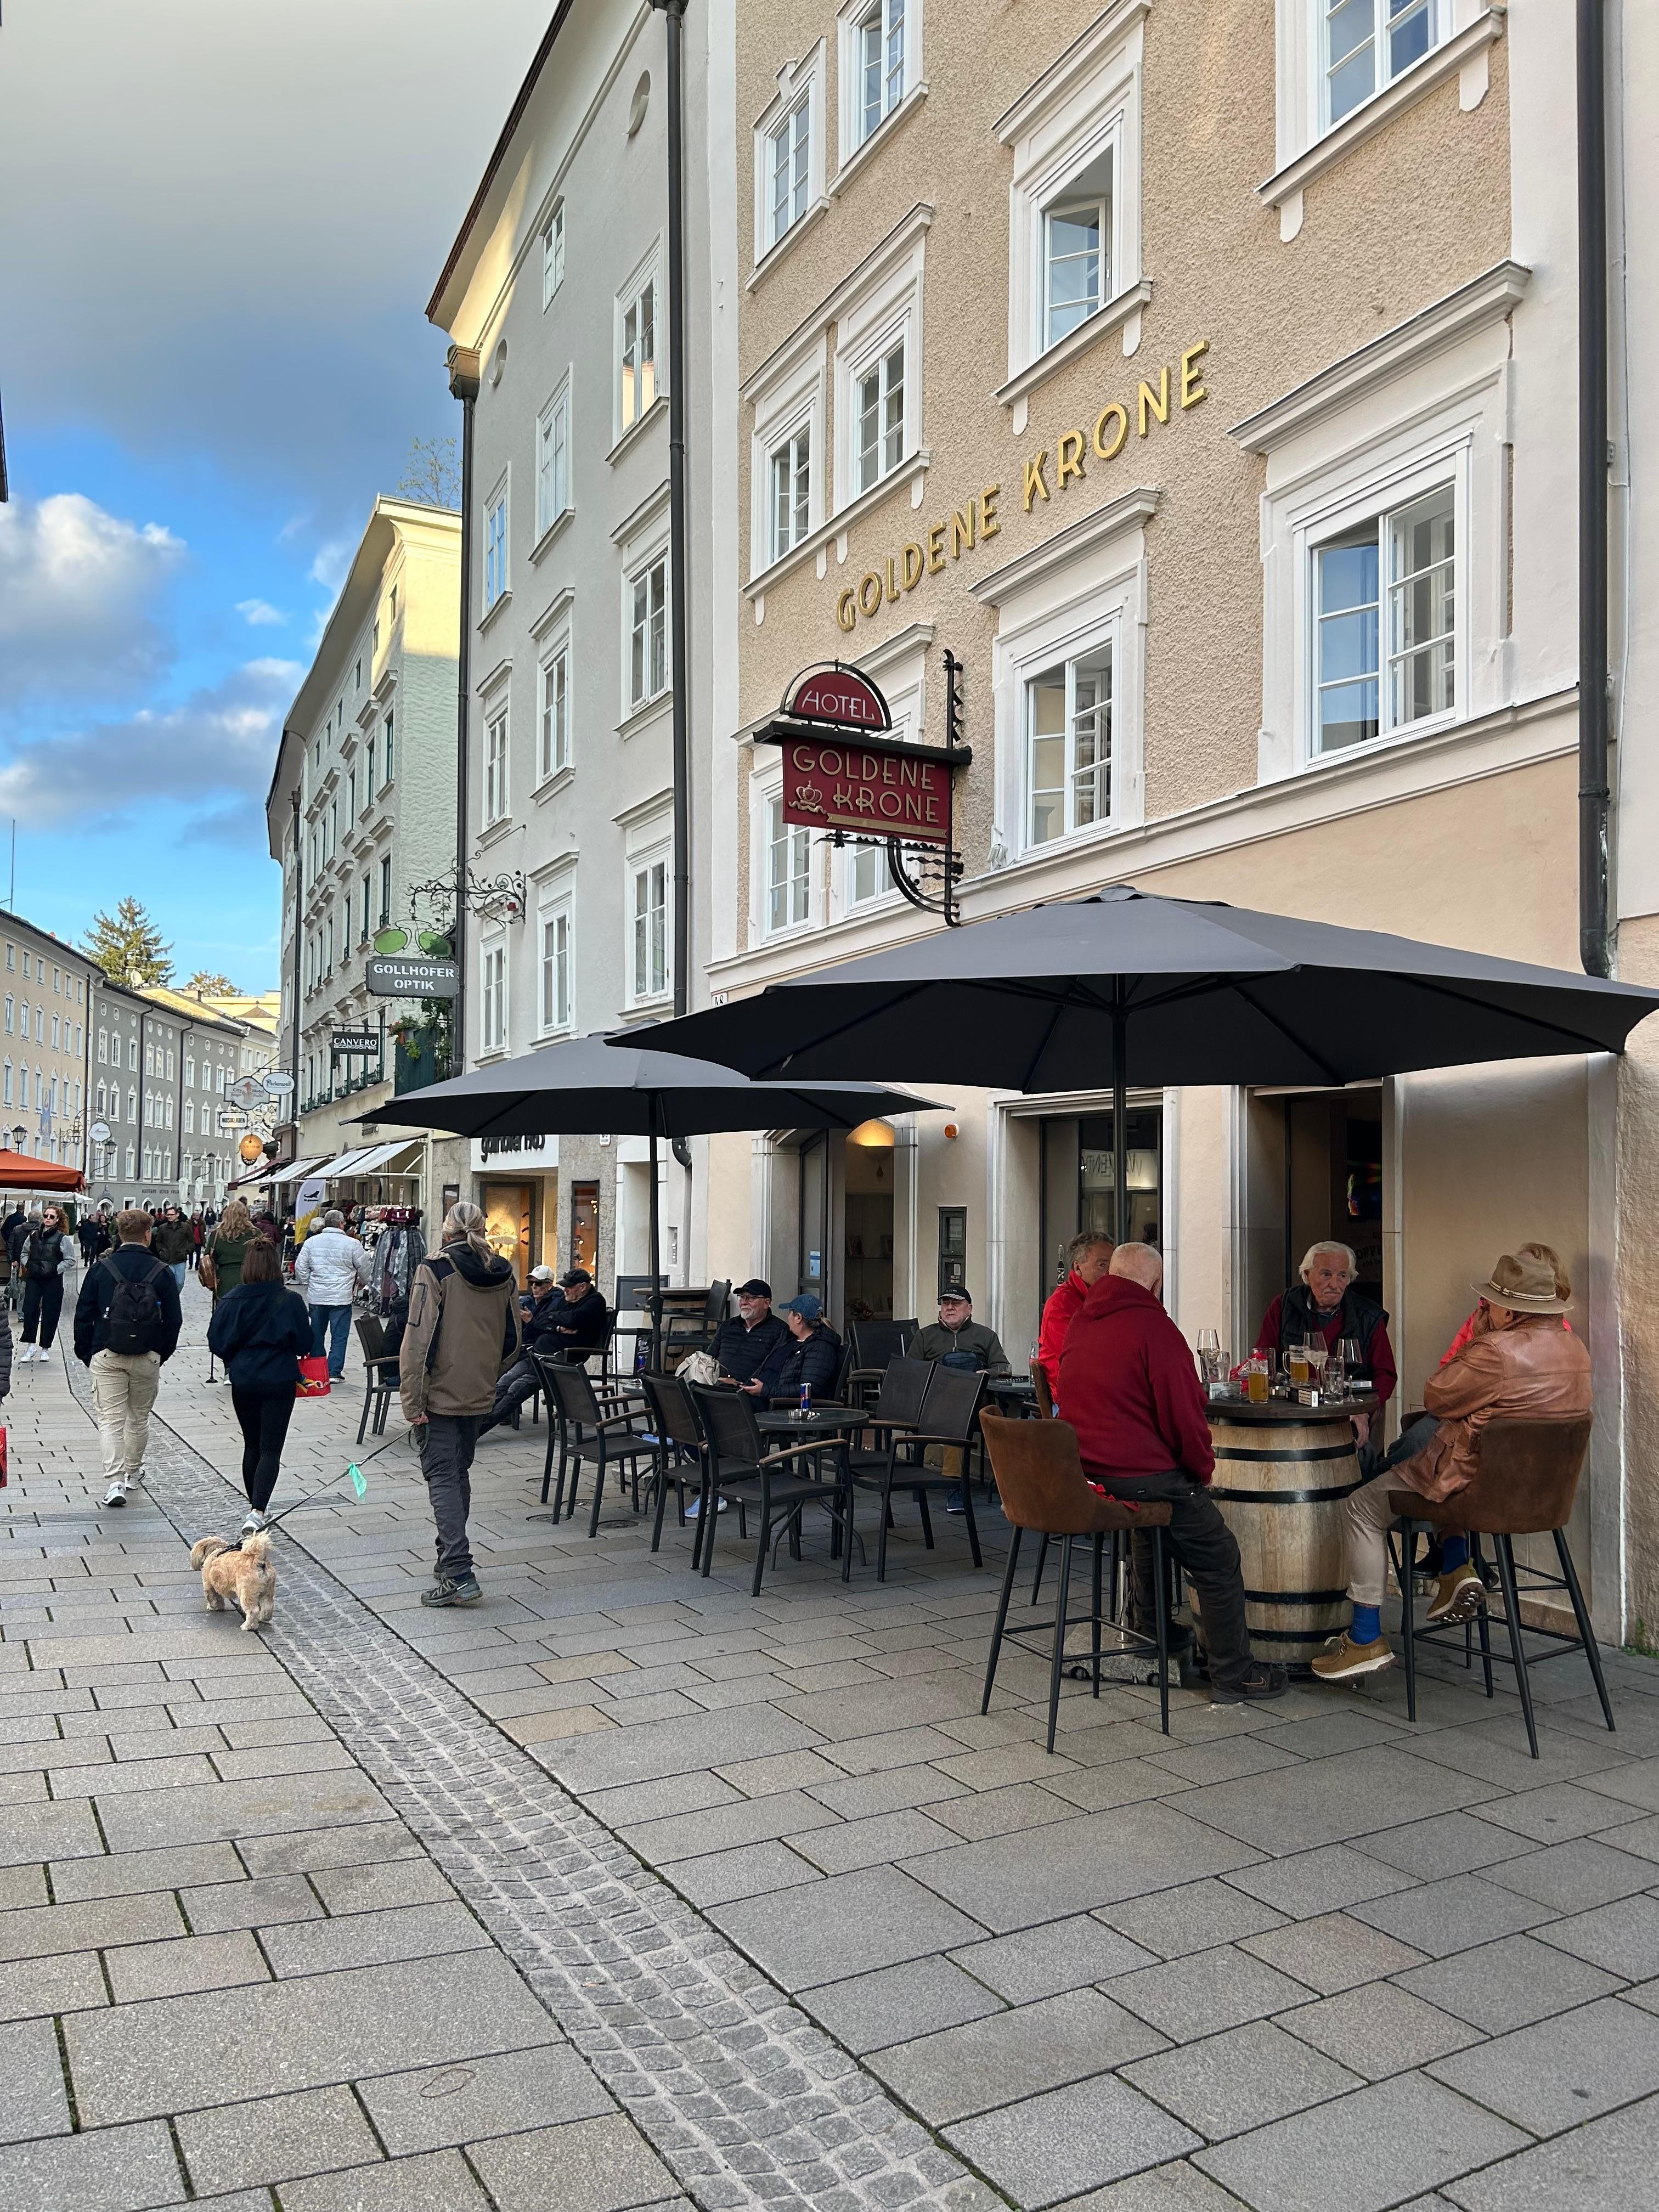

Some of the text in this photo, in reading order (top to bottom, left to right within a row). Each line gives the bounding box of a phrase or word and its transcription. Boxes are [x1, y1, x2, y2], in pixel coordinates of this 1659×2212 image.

[836, 340, 1210, 632] GOLDENE KRONE
[801, 690, 875, 720] HOTEL
[793, 745, 935, 791] GOLDENE
[833, 783, 940, 823] KRONE
[373, 964, 455, 978] GOLLHOFER
[394, 979, 435, 990] OPTIK
